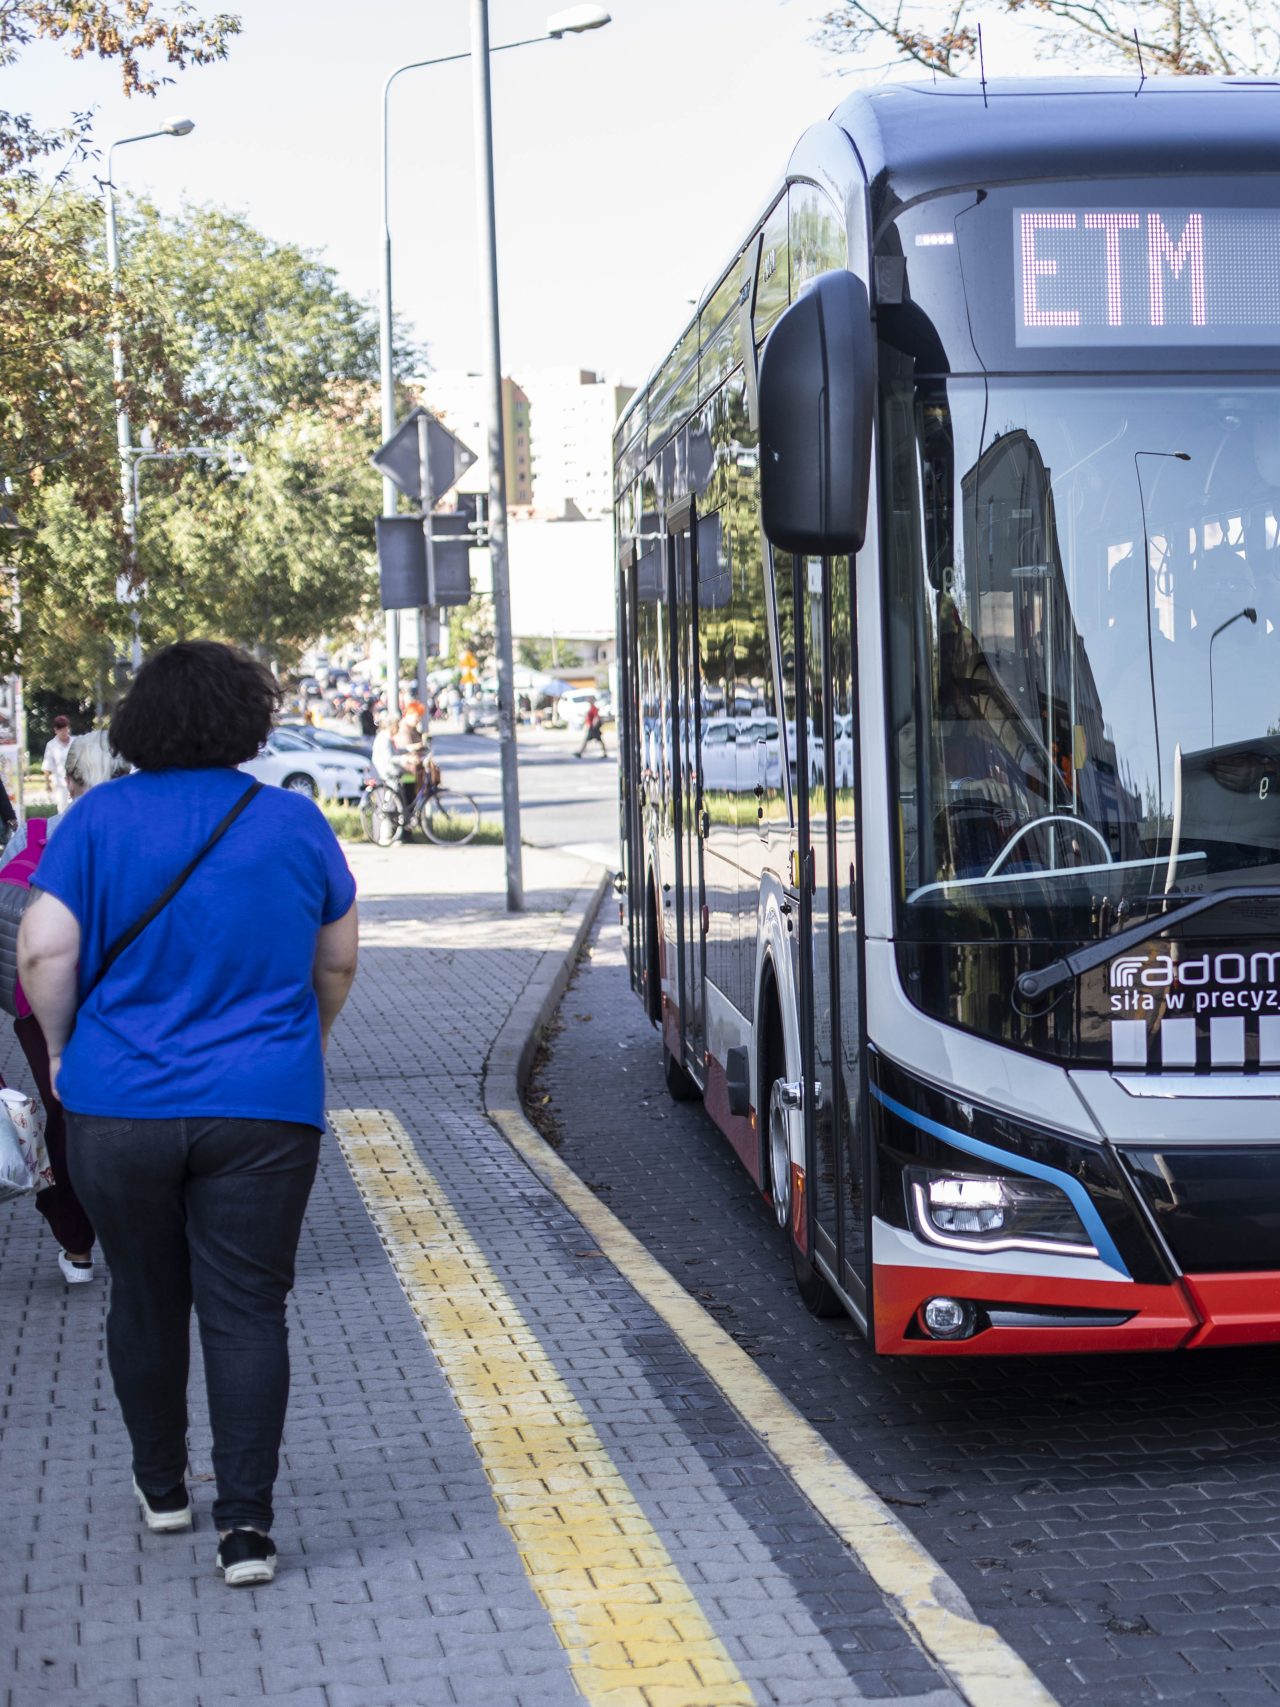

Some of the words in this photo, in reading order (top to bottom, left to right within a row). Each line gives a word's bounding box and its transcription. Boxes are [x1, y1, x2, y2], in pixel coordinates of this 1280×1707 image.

[1019, 211, 1206, 326] ETM
[1110, 989, 1154, 1011] siła
[1165, 993, 1186, 1009] w
